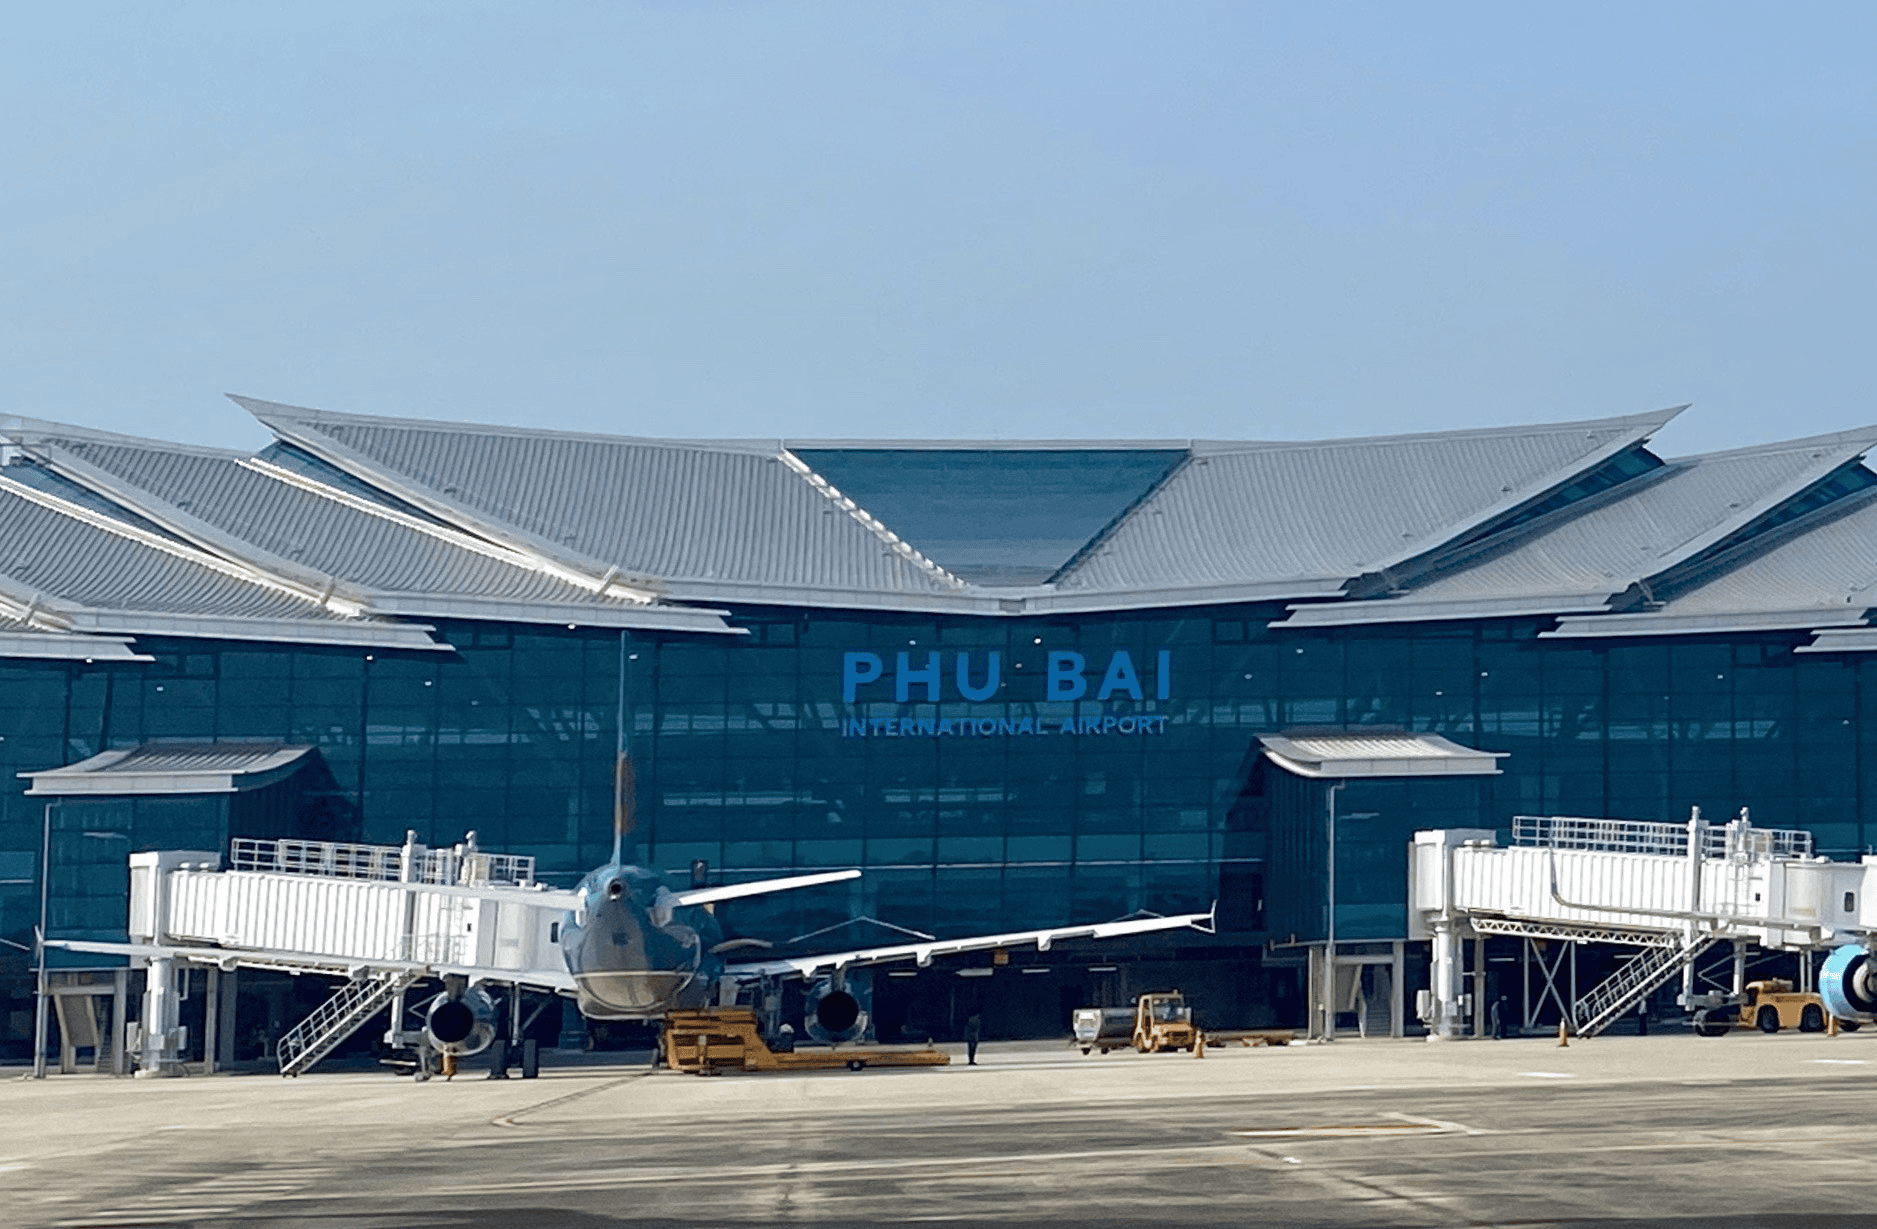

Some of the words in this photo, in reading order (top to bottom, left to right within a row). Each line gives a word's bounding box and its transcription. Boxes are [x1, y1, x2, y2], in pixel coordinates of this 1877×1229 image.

[843, 651, 1000, 701] PHU
[1047, 650, 1171, 701] BAI
[842, 717, 1049, 737] INTERNATIONAL
[1060, 715, 1169, 735] AIRPORT
